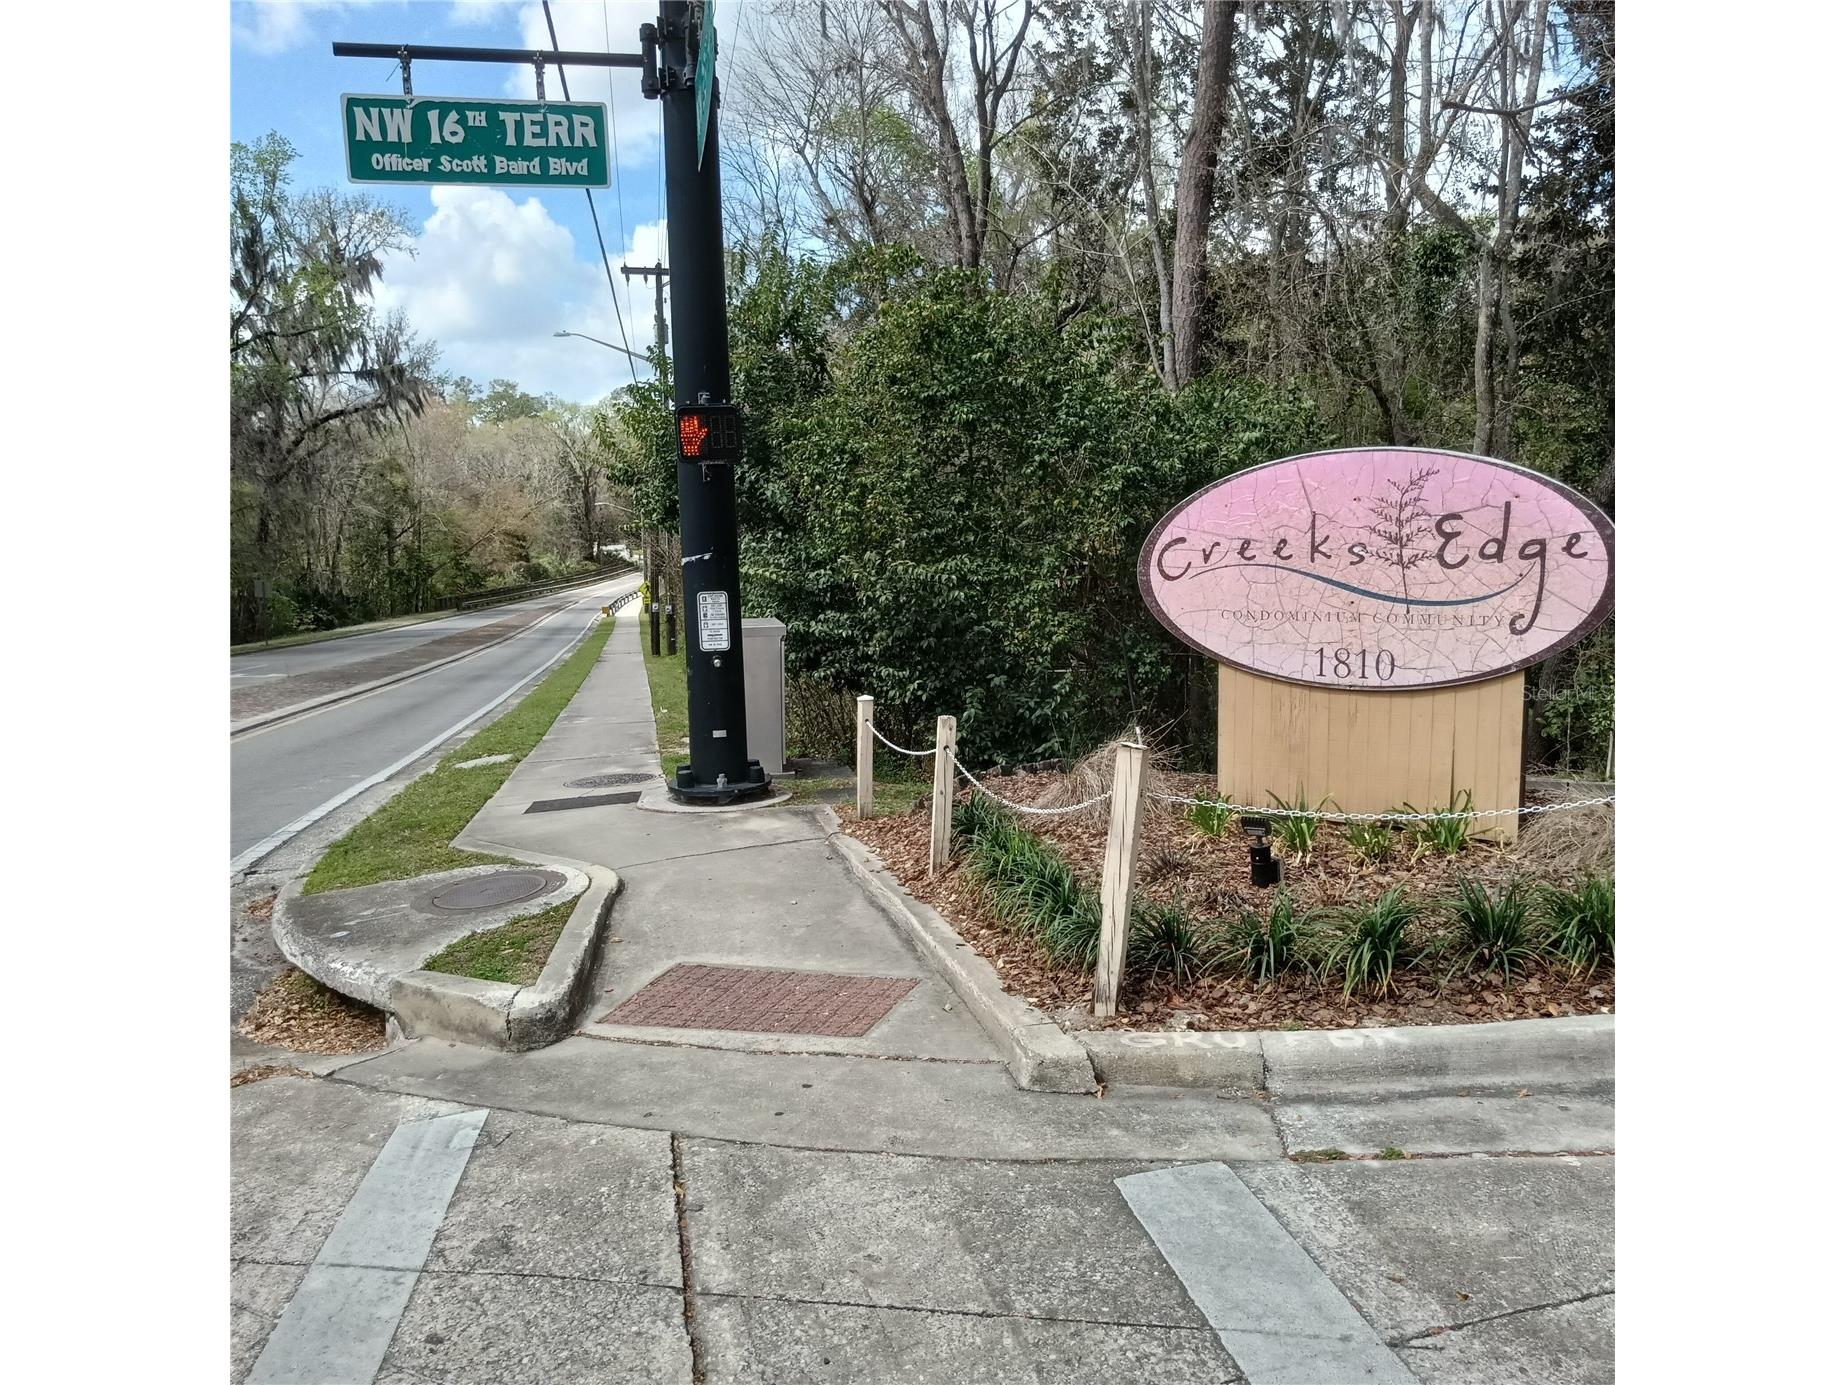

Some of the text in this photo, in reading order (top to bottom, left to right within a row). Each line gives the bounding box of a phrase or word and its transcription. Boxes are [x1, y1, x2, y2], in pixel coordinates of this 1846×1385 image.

[353, 106, 598, 148] NW 16TH TERR
[371, 153, 589, 176] Officer Scott Baird Blvd
[1157, 501, 1590, 636] Creeks Edge
[1221, 609, 1506, 627] CONDOMINIUM COMMUNITY
[1313, 646, 1396, 681] 1810
